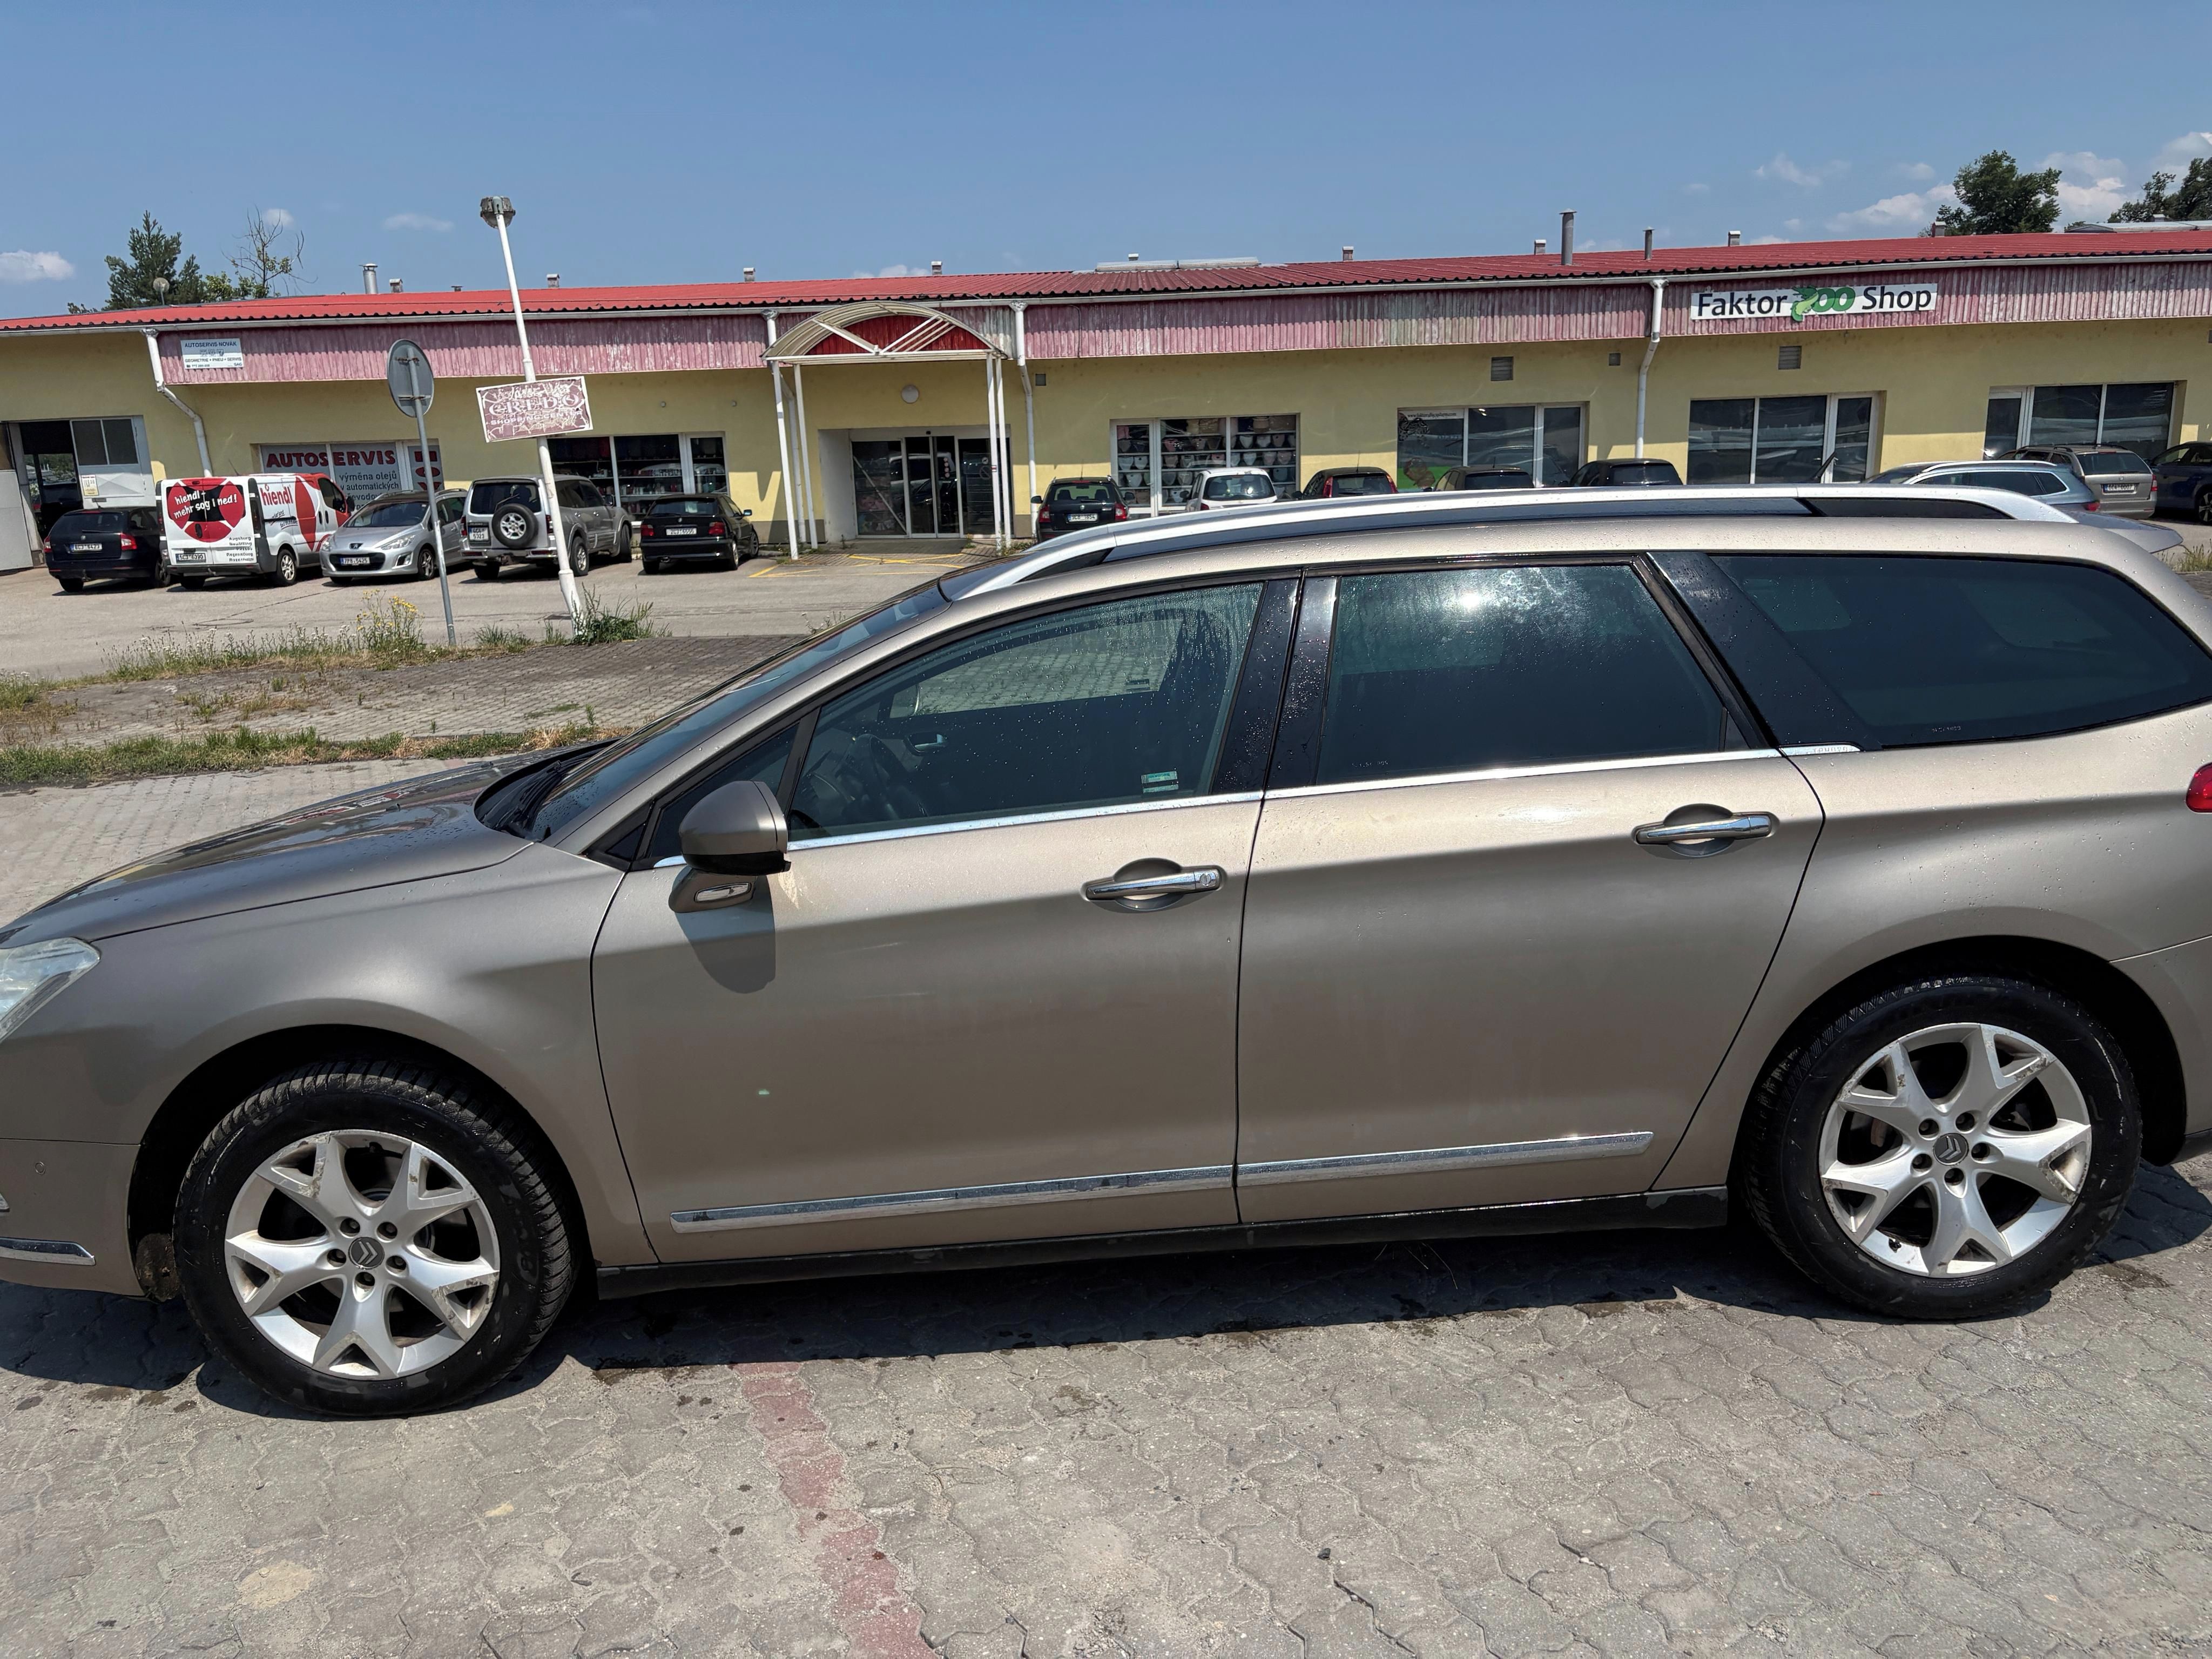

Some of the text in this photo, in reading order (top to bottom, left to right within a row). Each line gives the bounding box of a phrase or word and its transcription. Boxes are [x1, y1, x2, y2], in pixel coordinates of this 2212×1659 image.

[1697, 292, 1788, 316] Faktor
[1862, 286, 1932, 312] Shop
[490, 415, 543, 426] SHOPPING
[266, 450, 396, 468] AUTOSERVIS
[339, 470, 397, 482] výměna olejů
[347, 482, 399, 491] automatických
[174, 490, 200, 505] hiendl
[260, 484, 294, 506] hiendl
[174, 504, 194, 518] mehr
[195, 501, 210, 511] sog
